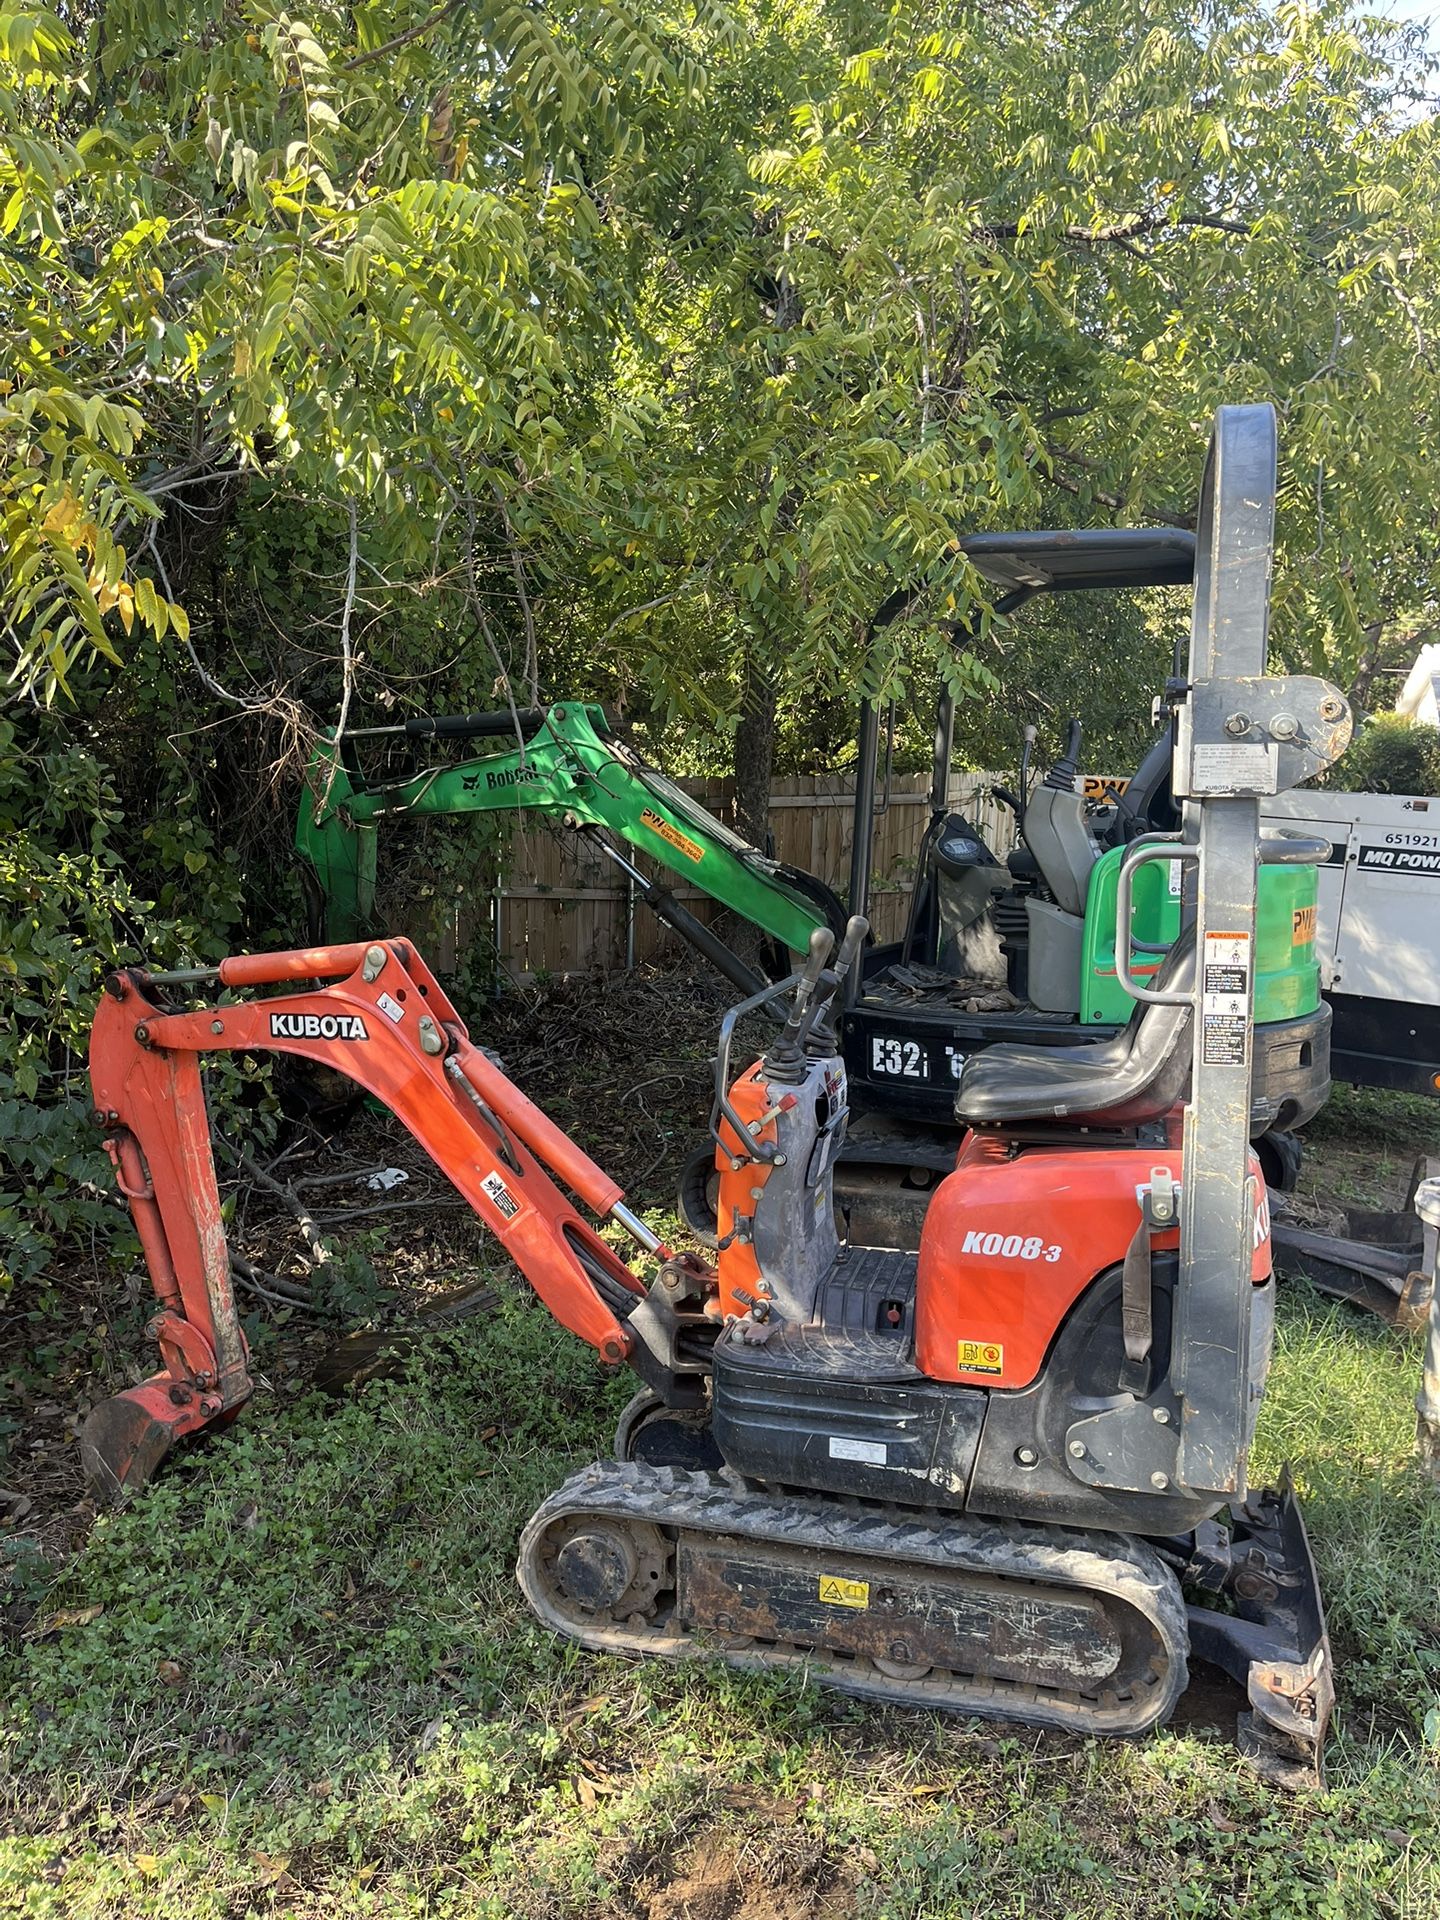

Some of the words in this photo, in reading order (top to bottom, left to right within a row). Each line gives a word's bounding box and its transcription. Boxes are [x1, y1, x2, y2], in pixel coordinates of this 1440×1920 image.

[486, 761, 539, 790] Bobcat
[1085, 778, 1126, 796] PW
[1385, 833, 1438, 847] 651921
[1363, 850, 1395, 867] MQ
[1395, 853, 1440, 869] POW
[270, 1014, 368, 1039] KUBOTA
[961, 1230, 1063, 1262] K008-3
